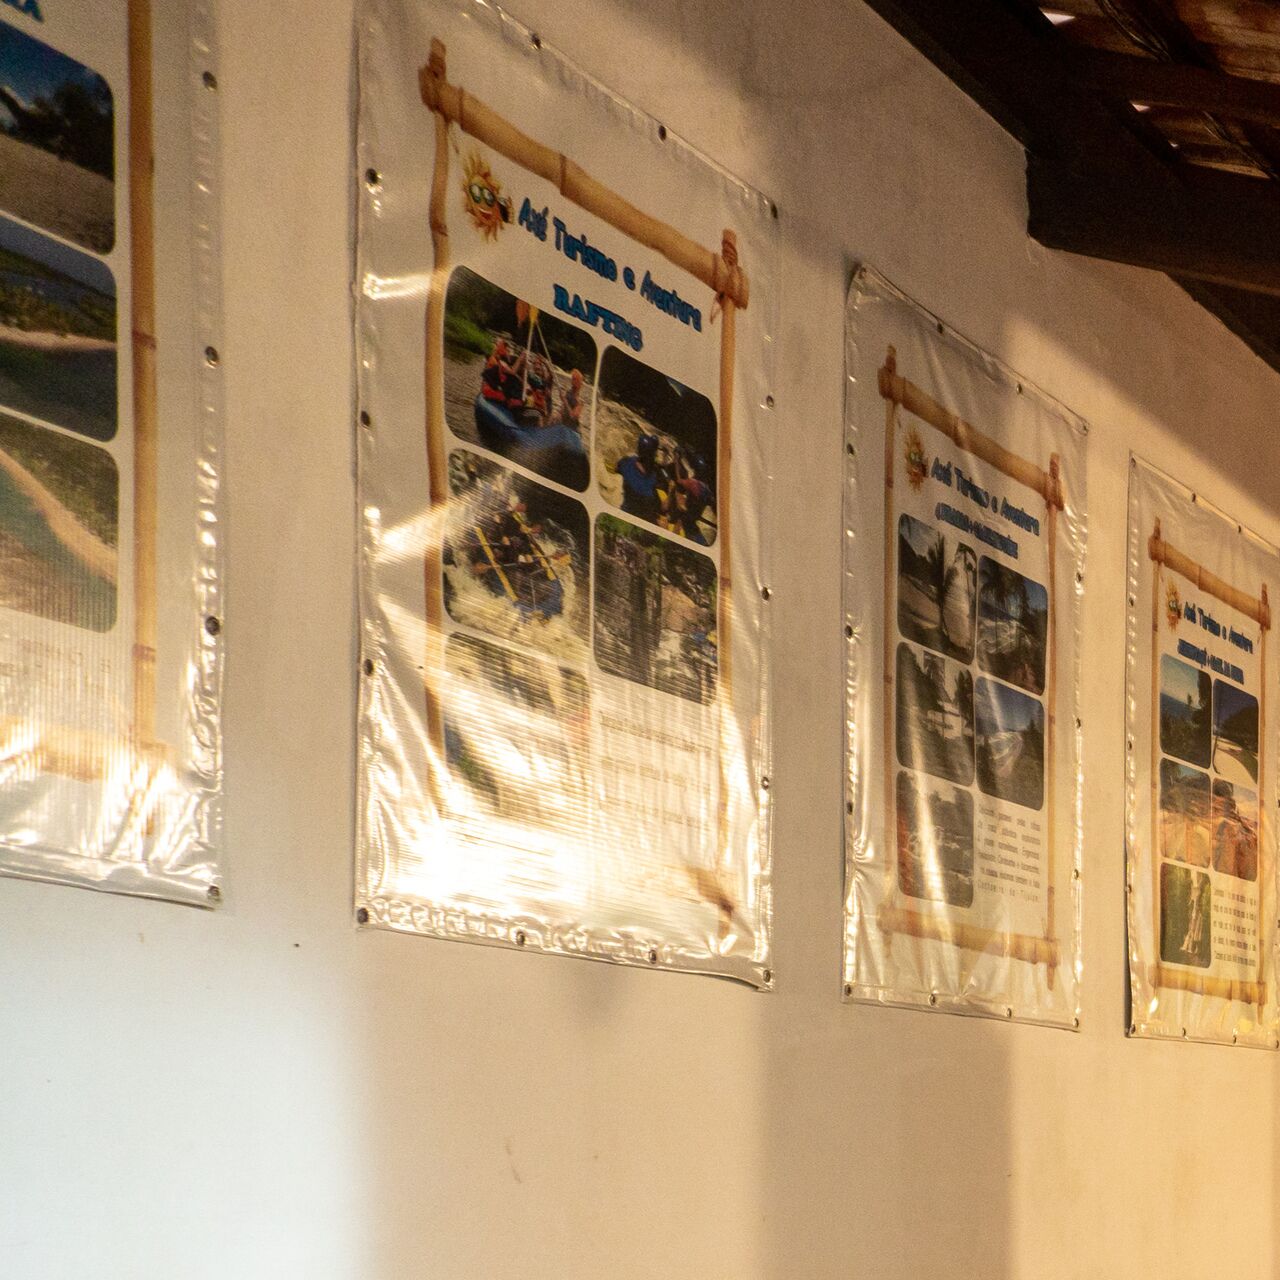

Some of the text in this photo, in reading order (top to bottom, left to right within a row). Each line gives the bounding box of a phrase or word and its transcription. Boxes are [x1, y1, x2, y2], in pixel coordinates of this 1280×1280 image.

[518, 197, 702, 333] Axé Turismo e Aventura
[553, 283, 643, 352] RAFTING
[931, 456, 952, 487] Axé
[954, 467, 989, 509] Turismo
[991, 495, 998, 513] e
[1000, 496, 1040, 537] Aventura
[1197, 607, 1221, 637] Turismo
[1222, 625, 1227, 640] e
[1228, 625, 1253, 654] Aventura
